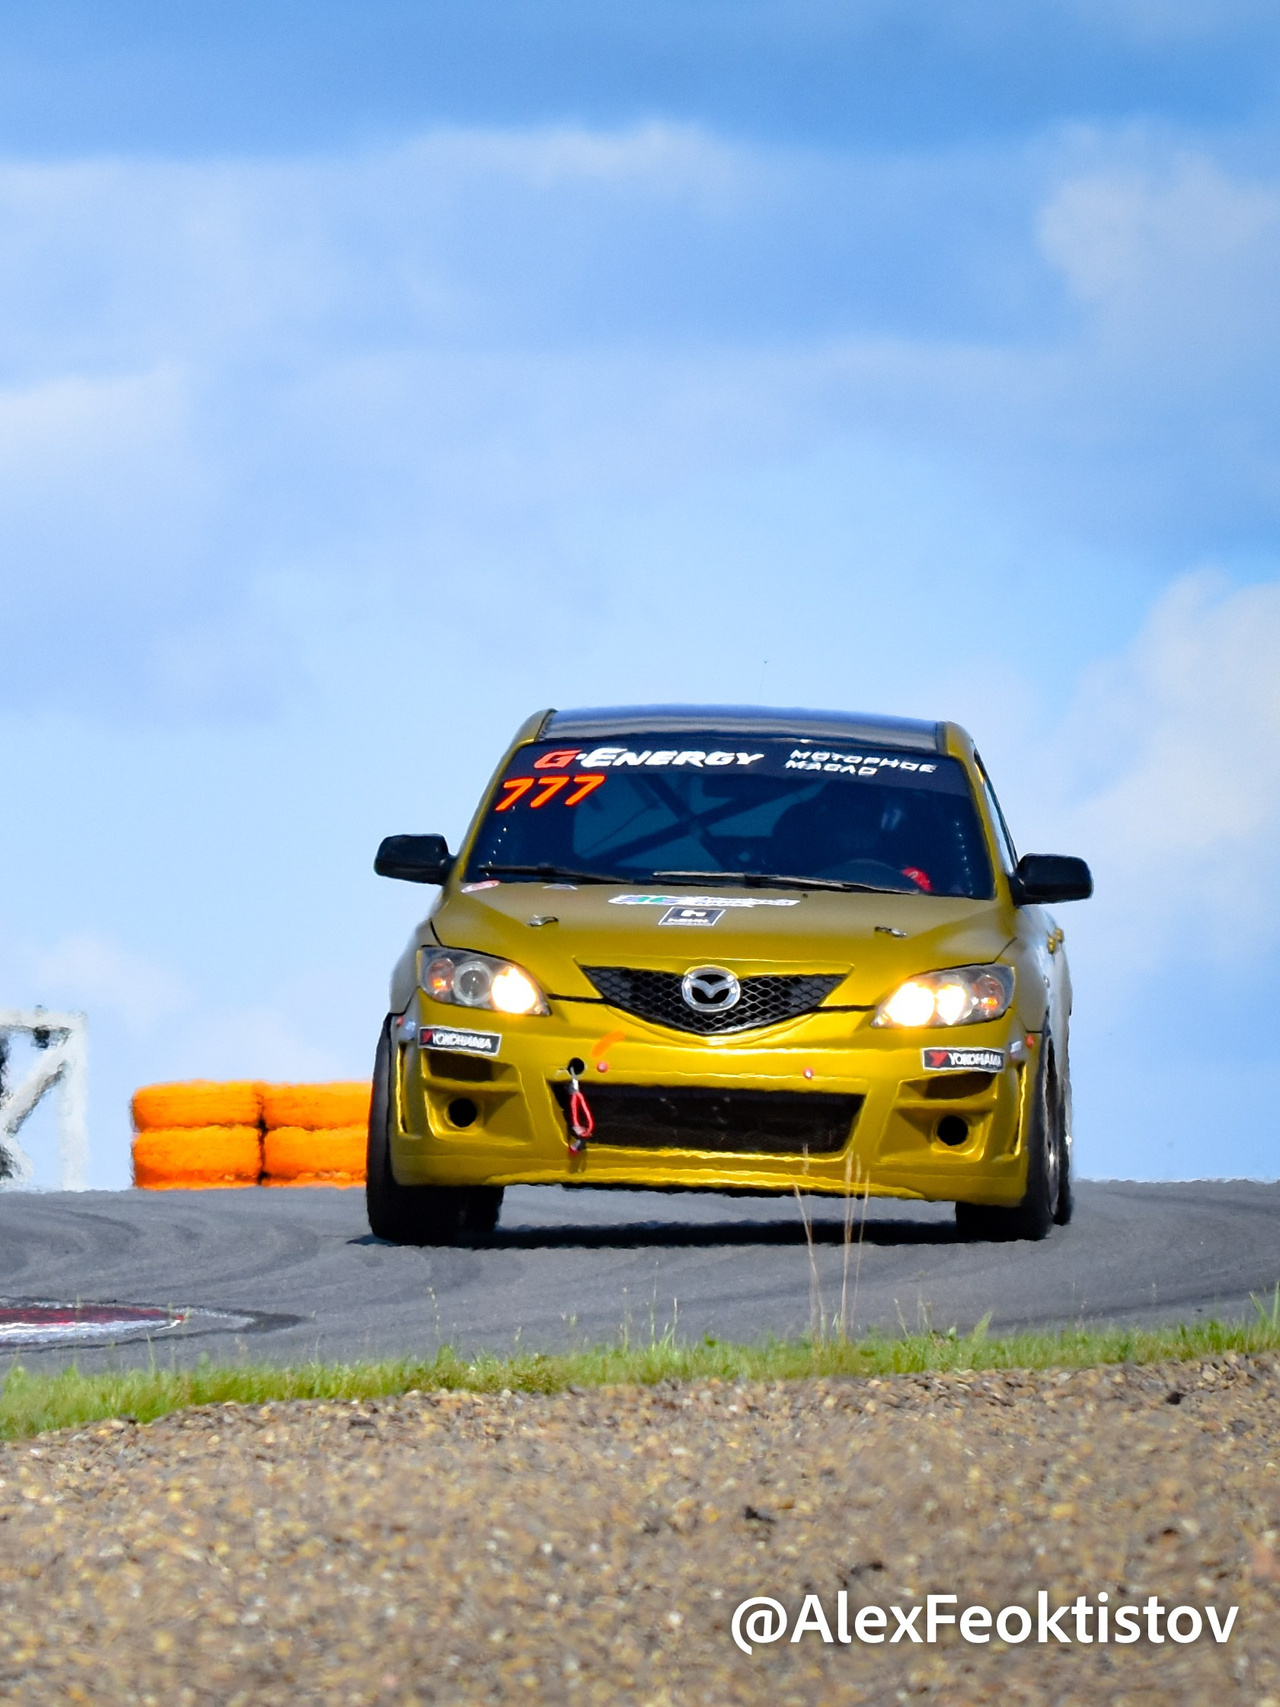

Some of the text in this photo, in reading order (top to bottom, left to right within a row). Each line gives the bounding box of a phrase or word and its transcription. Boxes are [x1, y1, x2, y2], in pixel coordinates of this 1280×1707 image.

[785, 760, 878, 777] МАСЛО
[789, 749, 938, 774] МОТОРНОЕ
[494, 774, 607, 812] 777
[432, 1032, 492, 1049] YOKOHAMA
